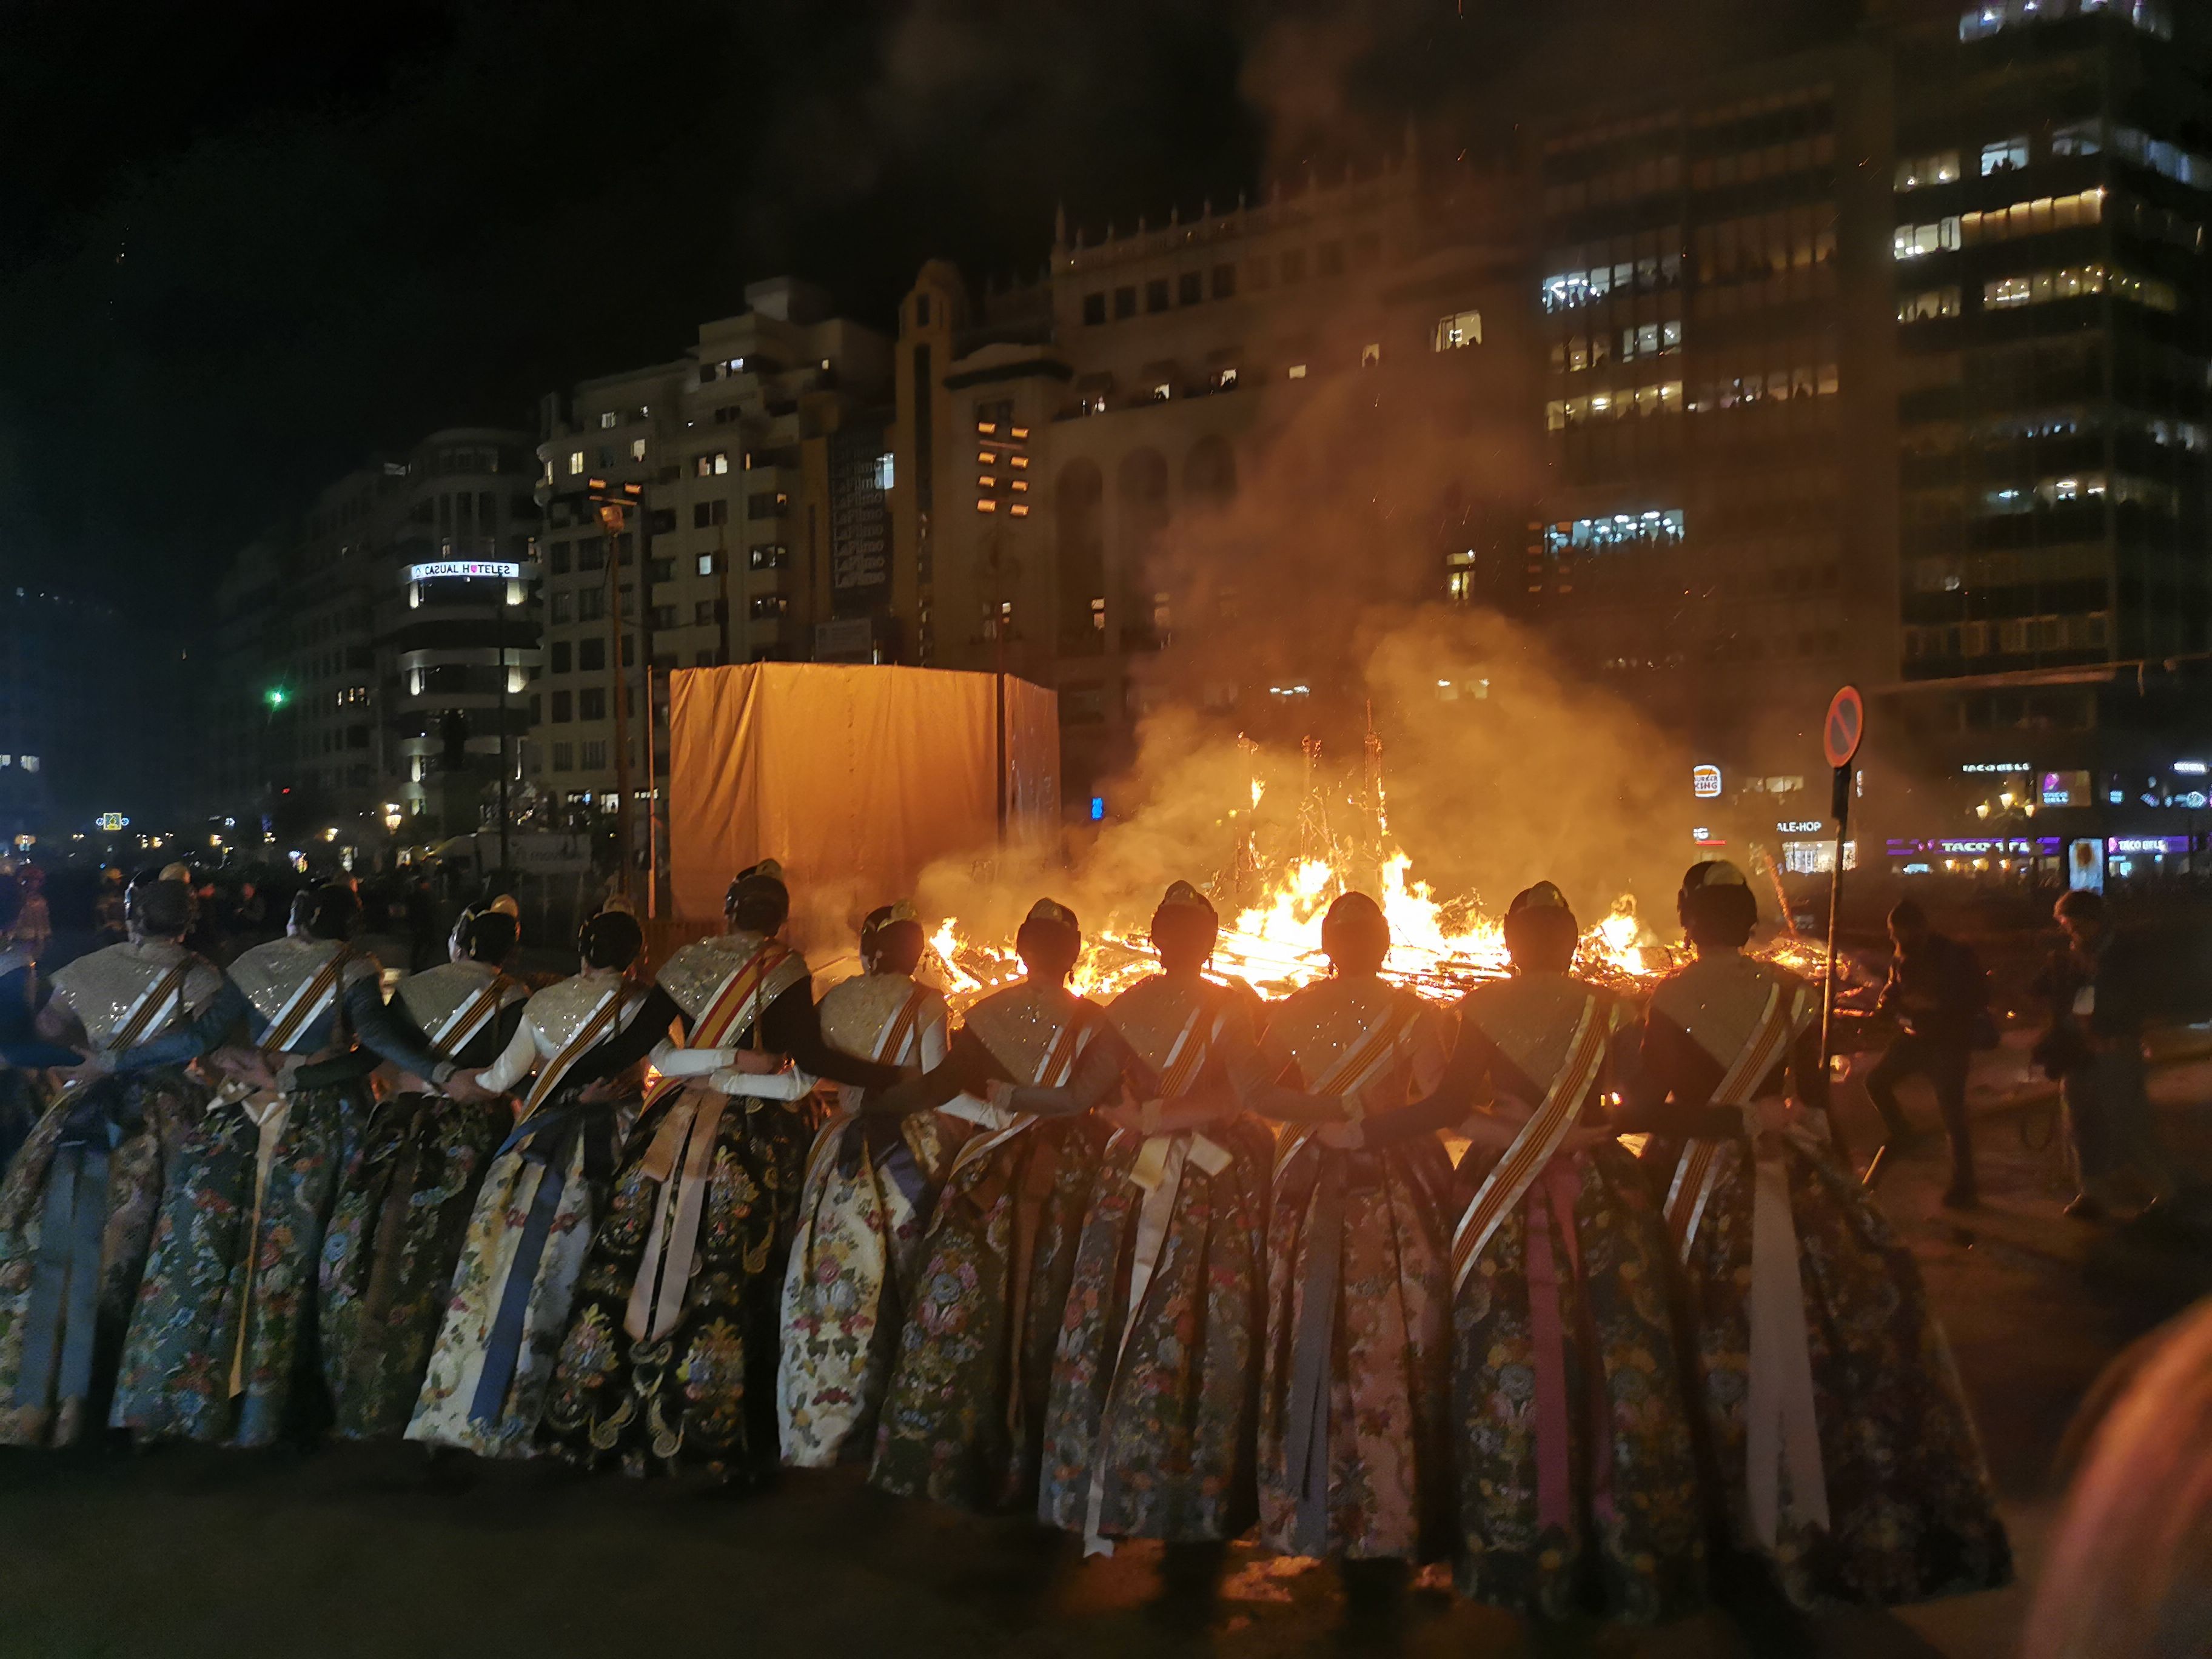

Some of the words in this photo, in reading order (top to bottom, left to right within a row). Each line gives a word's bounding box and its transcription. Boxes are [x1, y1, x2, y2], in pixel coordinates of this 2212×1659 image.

[425, 564, 459, 575] CASUAL
[1942, 842, 1991, 852] TACO
[2118, 840, 2142, 851] TACO
